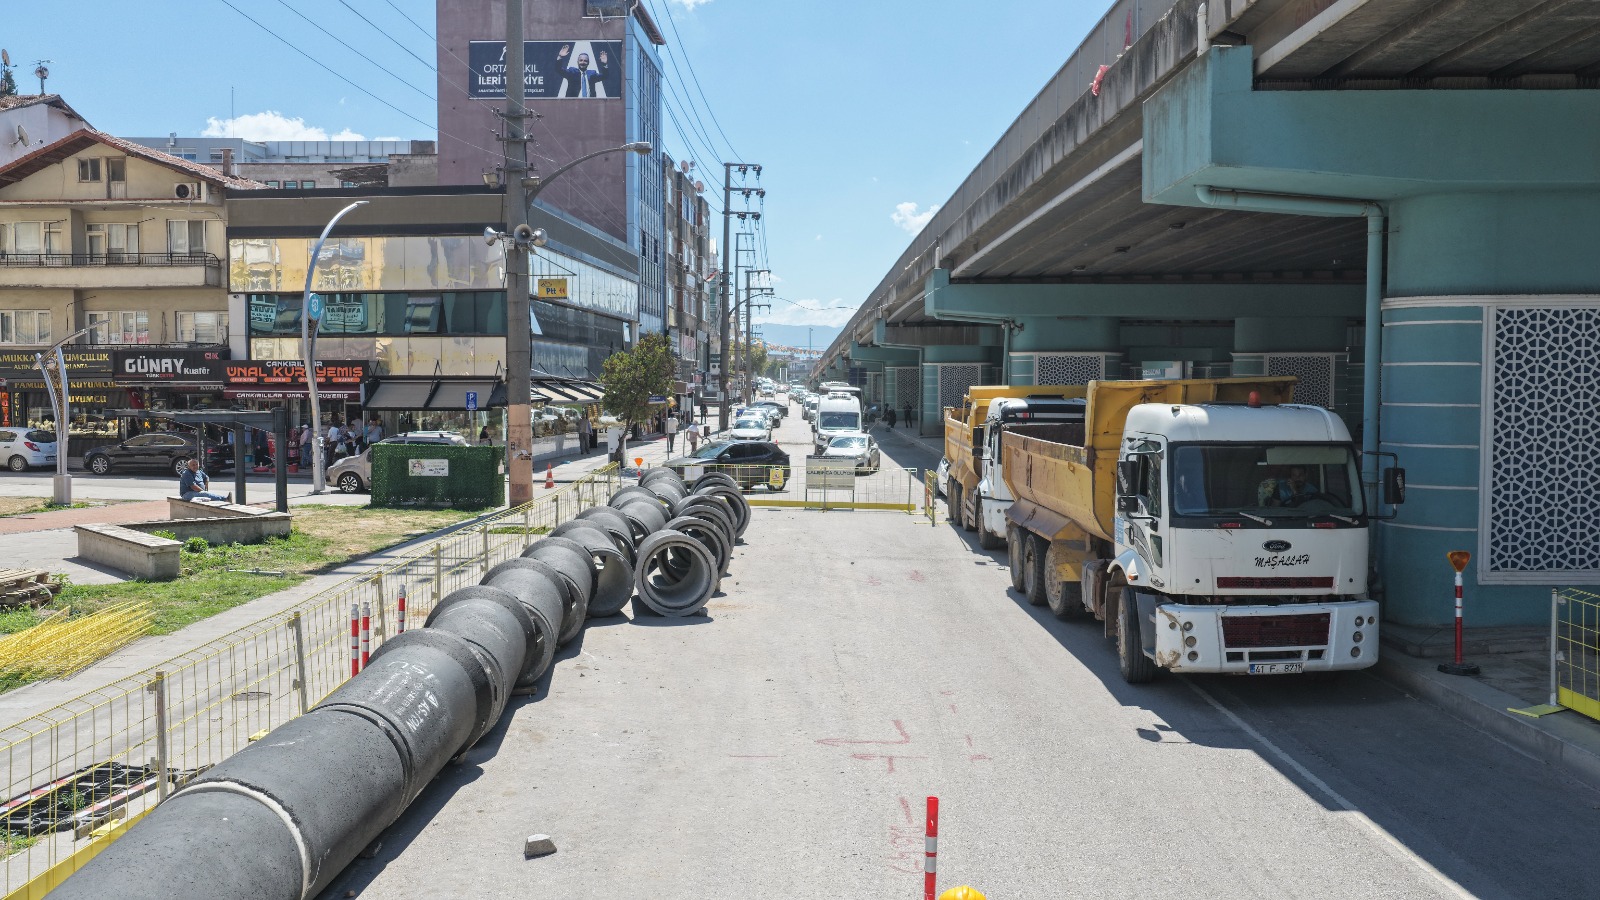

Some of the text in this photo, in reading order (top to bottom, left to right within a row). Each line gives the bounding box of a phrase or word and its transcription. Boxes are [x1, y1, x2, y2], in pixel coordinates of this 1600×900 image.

[523, 64, 539, 73] KIL
[478, 75, 544, 85] İLERİ TKİYE
[125, 356, 210, 375] GÜNAY Kuaför
[67, 395, 107, 403] UYUMCU
[1254, 554, 1310, 569] MAŞALLAH
